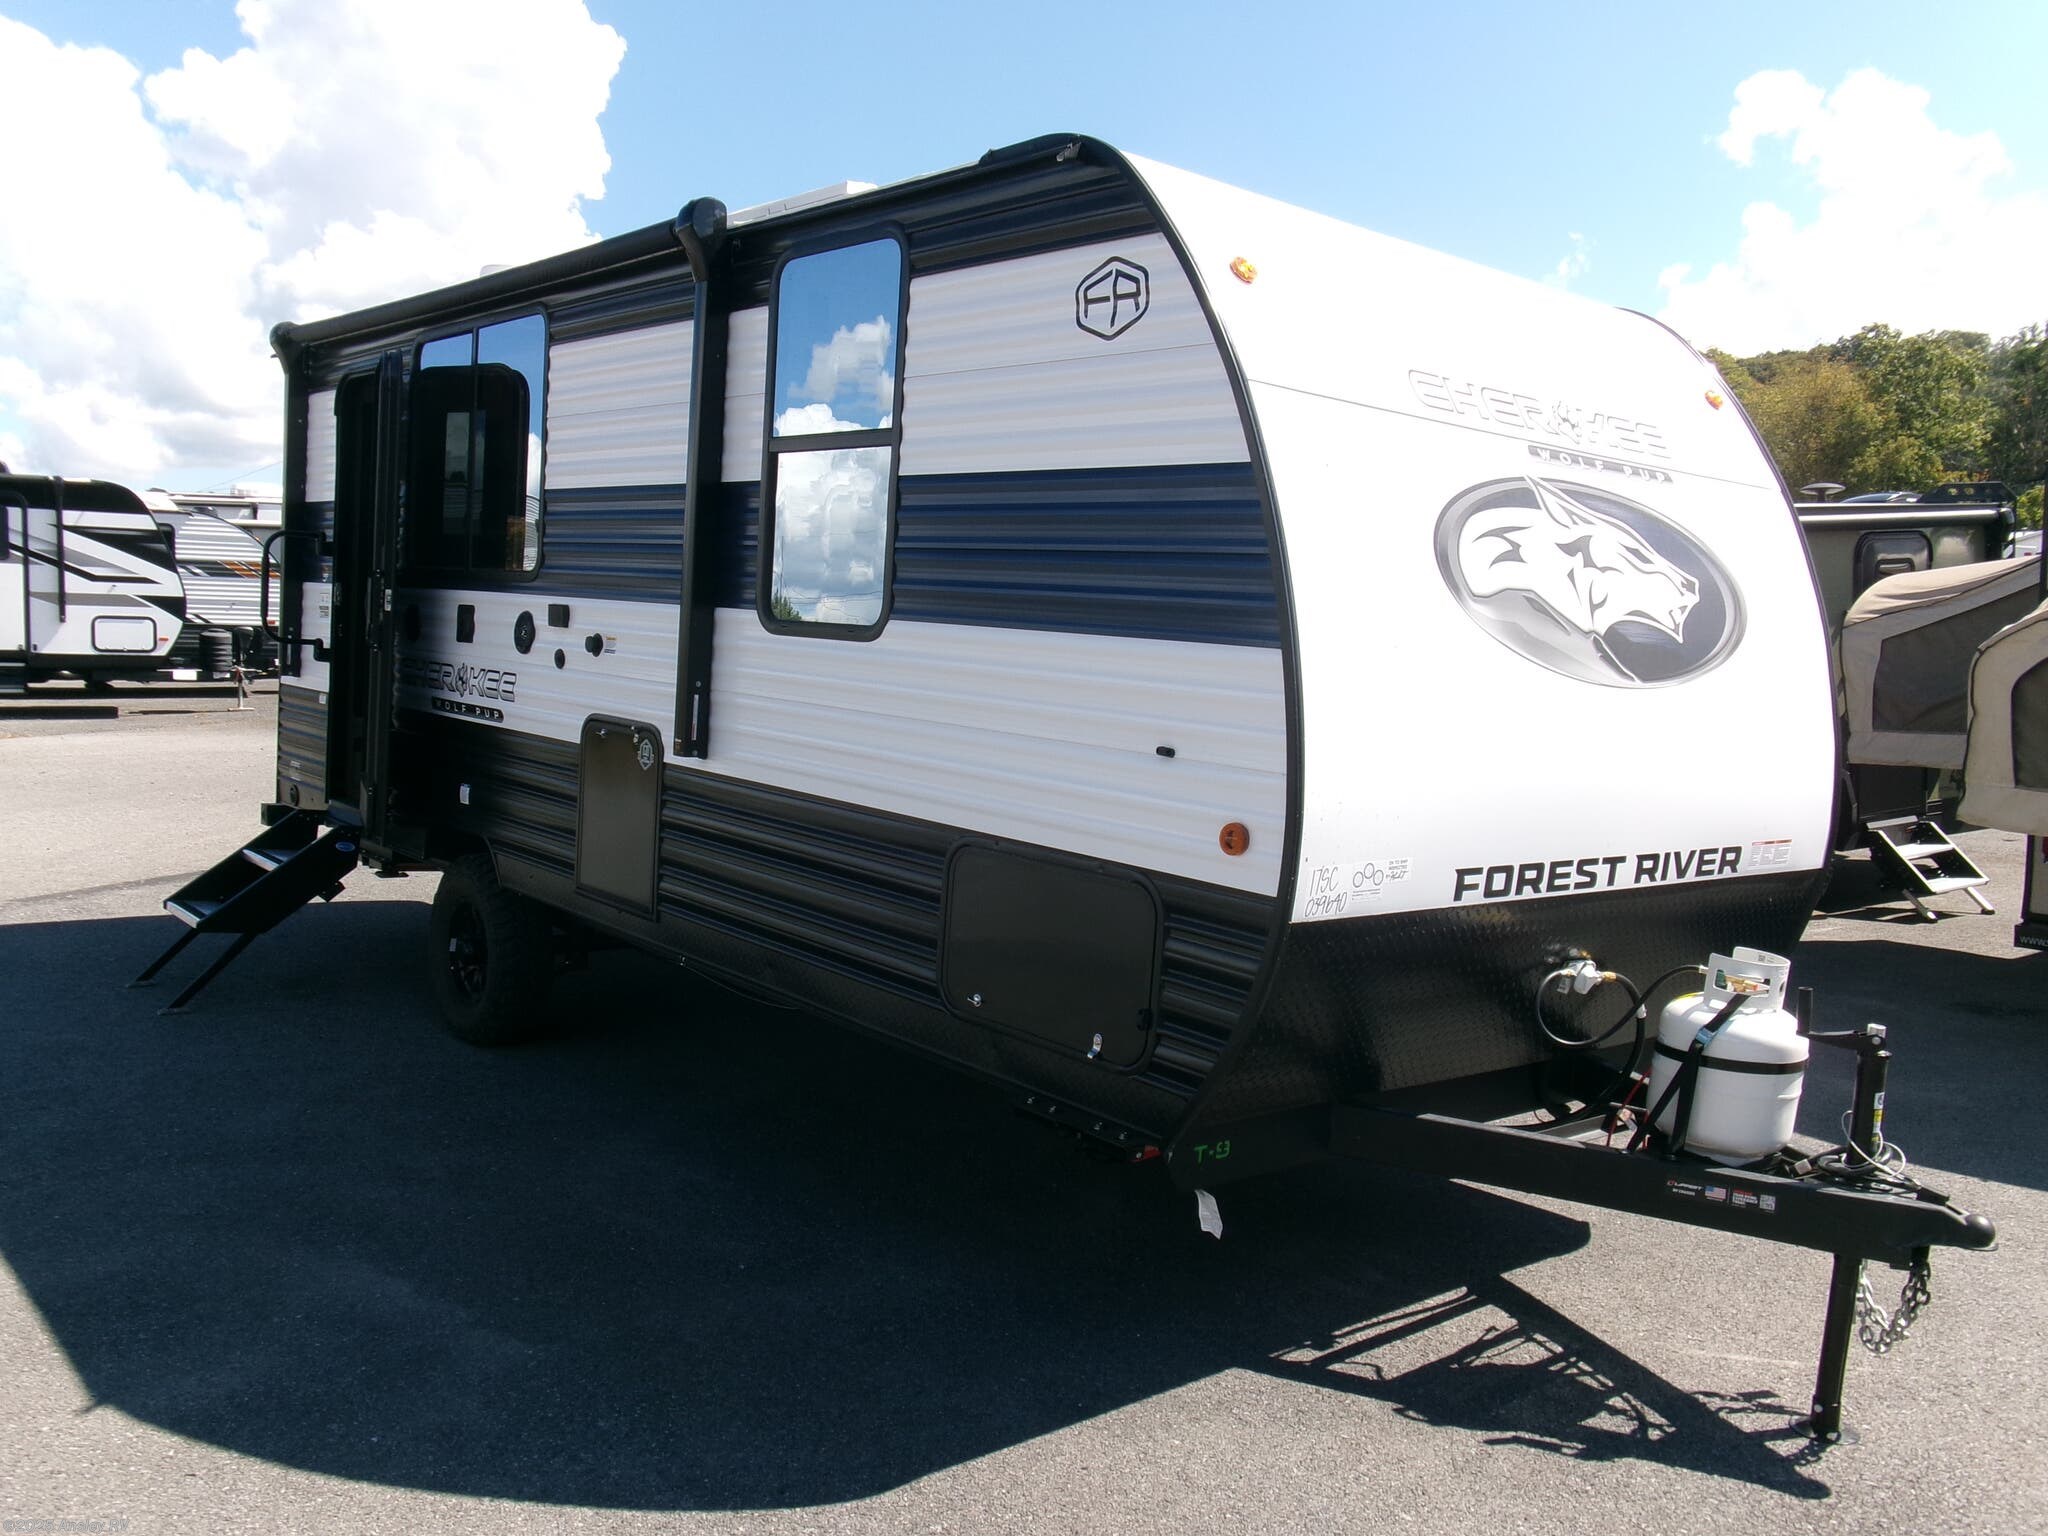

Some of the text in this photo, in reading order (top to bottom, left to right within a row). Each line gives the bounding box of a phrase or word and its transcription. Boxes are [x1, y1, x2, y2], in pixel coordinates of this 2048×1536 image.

[1536, 447, 1667, 484] WOLF PUP
[474, 707, 500, 720] PUP
[1453, 855, 1627, 902] FOREST
[1633, 845, 1742, 885] RIVER
